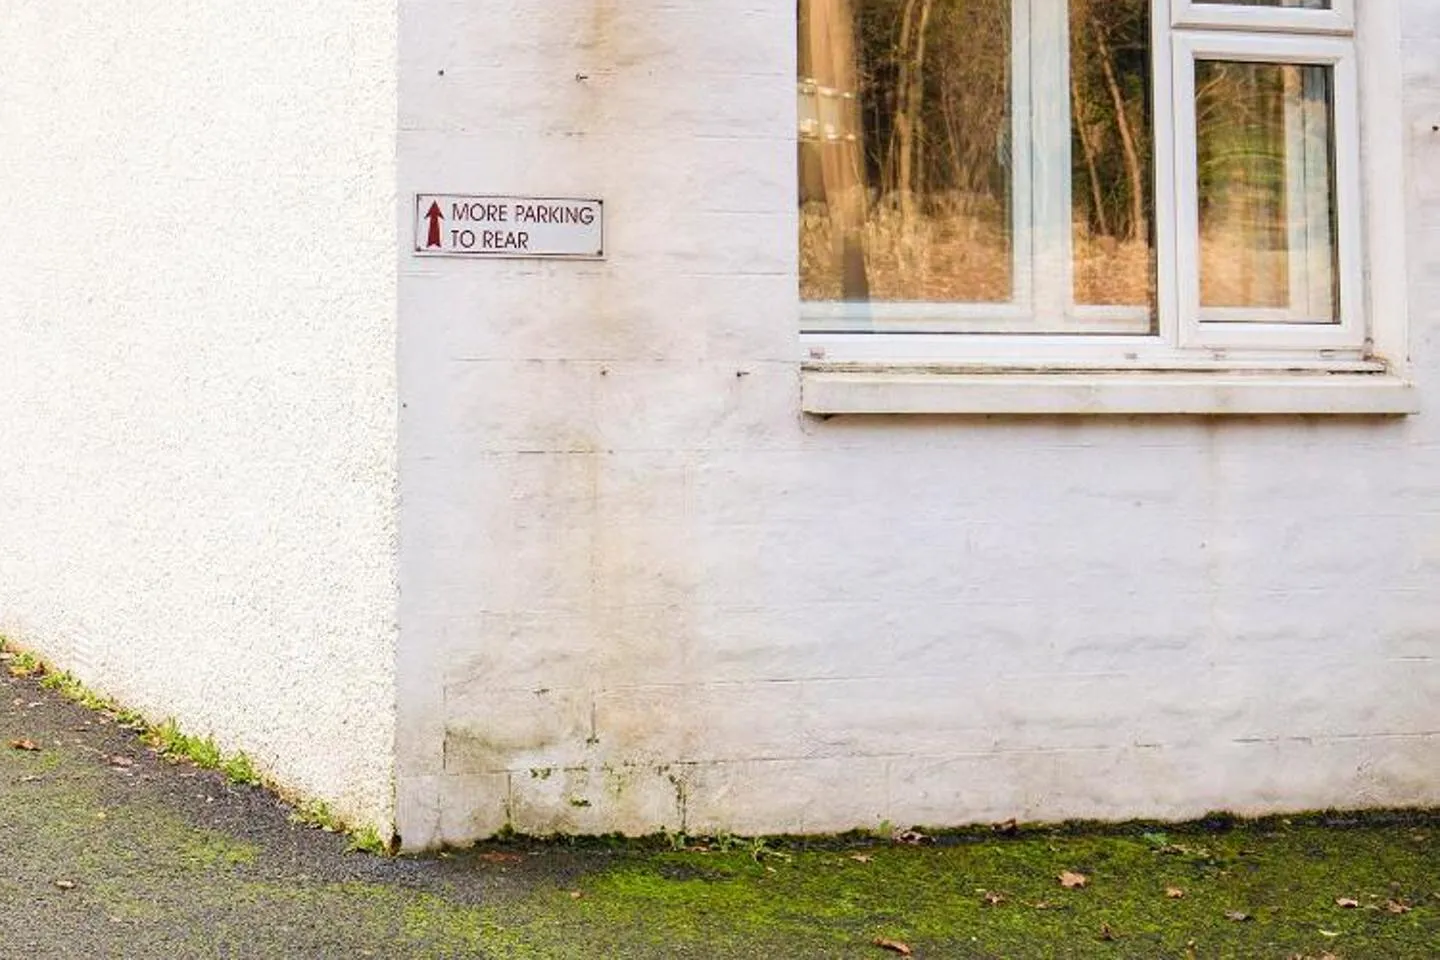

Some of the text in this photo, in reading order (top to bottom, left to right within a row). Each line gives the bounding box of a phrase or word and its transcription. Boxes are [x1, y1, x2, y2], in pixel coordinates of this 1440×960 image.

[452, 203, 594, 225] MORE PARKING
[451, 230, 529, 249] TO REAR
